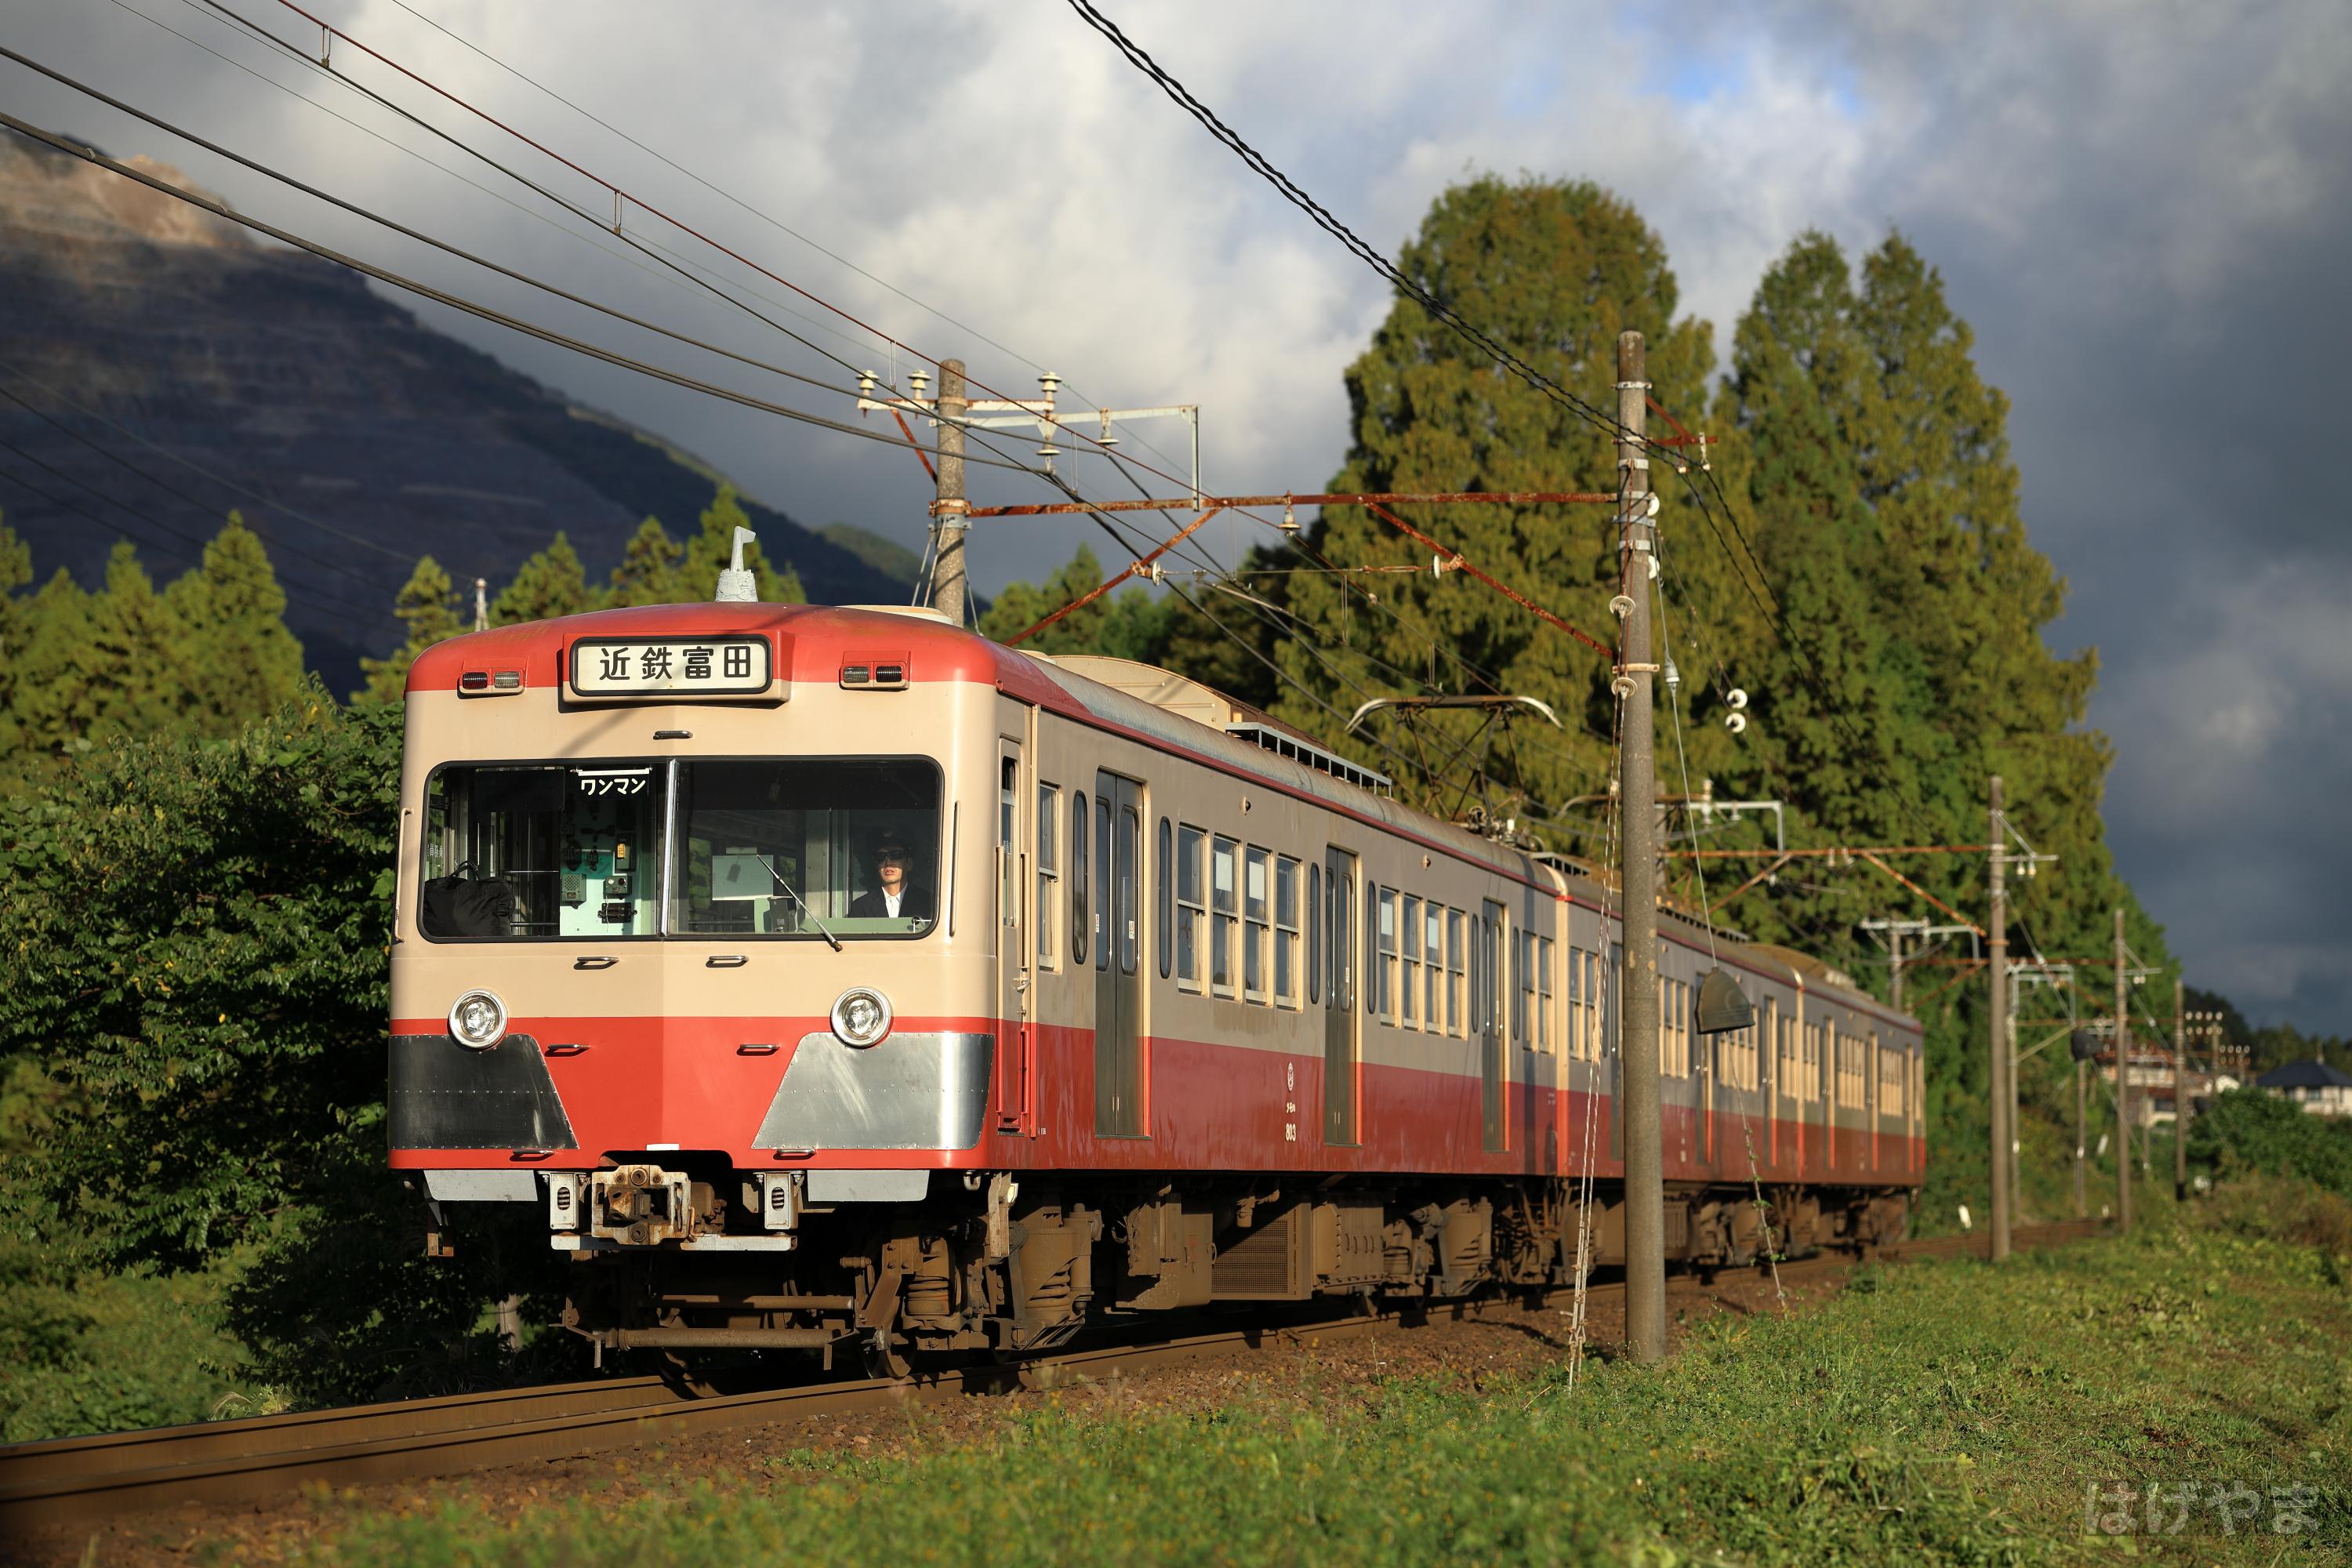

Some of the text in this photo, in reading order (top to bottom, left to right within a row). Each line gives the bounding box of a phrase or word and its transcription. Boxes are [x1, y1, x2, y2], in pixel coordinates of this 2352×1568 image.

[599, 646, 751, 681] 近鉄富田
[581, 778, 646, 796] ワンマン
[1286, 1123, 1296, 1142] 803
